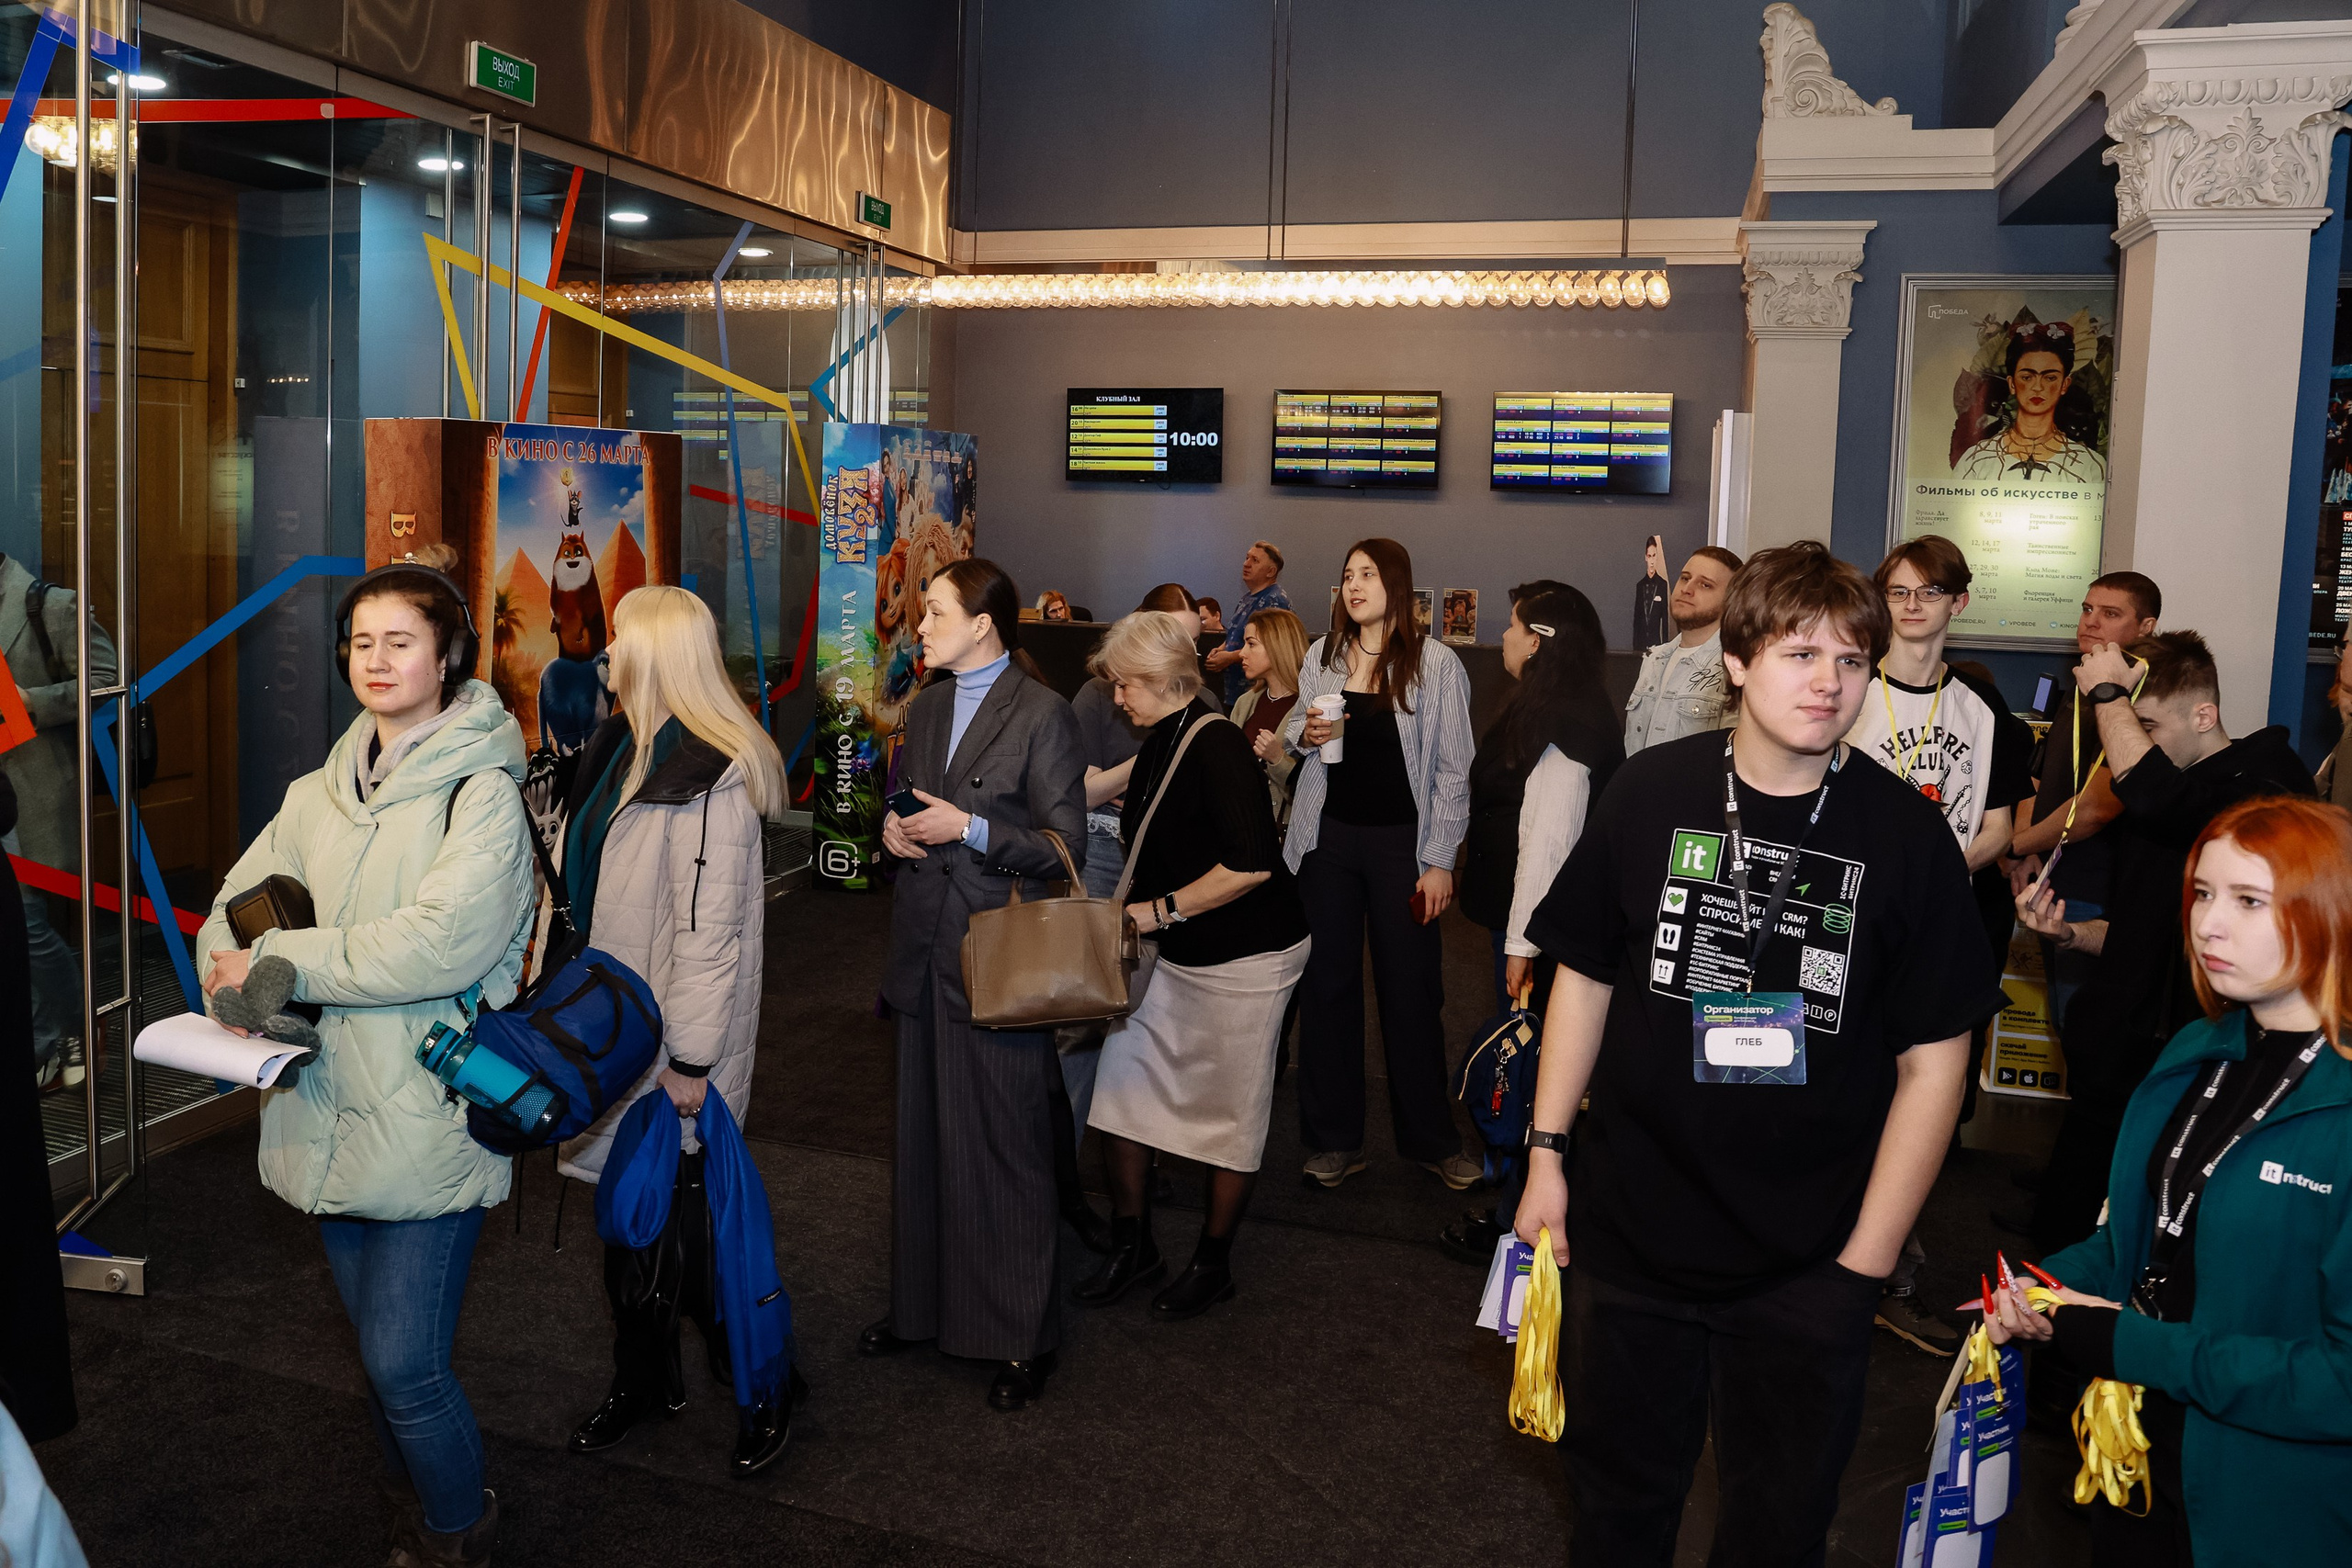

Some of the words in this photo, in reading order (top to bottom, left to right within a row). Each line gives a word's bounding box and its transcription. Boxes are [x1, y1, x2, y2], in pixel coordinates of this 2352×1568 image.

[492, 56, 520, 82] ВЫХОД
[498, 76, 514, 91] EXIT
[1170, 432, 1218, 446] 10:00
[487, 436, 498, 457] В
[504, 438, 559, 460] КИНО
[562, 441, 574, 461] С
[579, 442, 596, 463] 26
[600, 445, 650, 465] МАРТА
[1916, 484, 1975, 496] Фильмы
[1981, 487, 1998, 497] об
[2004, 490, 2078, 500] искусстве
[823, 475, 839, 550] ДОМОВЁНОК
[837, 467, 869, 563] КУЗЯ
[855, 505, 876, 527] 2
[841, 590, 857, 668] МАРТА
[836, 676, 854, 704] 19
[839, 713, 854, 727] С
[1880, 725, 1971, 761] HELLFRE
[837, 735, 854, 793] КИНО
[837, 803, 852, 814] В
[1815, 785, 1829, 814] construct
[1681, 840, 1707, 871] it
[1732, 829, 1740, 861] construct
[1839, 864, 1852, 900] 1С-БИТРИКС
[1848, 866, 1860, 900] БИТРИКС24
[1739, 889, 1747, 921] construct
[1782, 912, 1808, 925] CRM?
[1780, 924, 1805, 939] КАК!
[1690, 953, 1724, 965] #ТЕХНИЧЕСКАЯ
[1691, 947, 1716, 957] #СИСТЕМА
[1688, 965, 1730, 980] #КОРПОРАТИВНЫЕ
[1690, 960, 1720, 971] #1С-БИТРИКС
[1686, 978, 1713, 988] #ОБУЧЕНИЕ
[1703, 1004, 1774, 1016] Организатор
[1736, 1037, 1762, 1046] ГЛЕБ
[2175, 1191, 2196, 1225] construct
[1978, 1425, 2009, 1442] Участник
